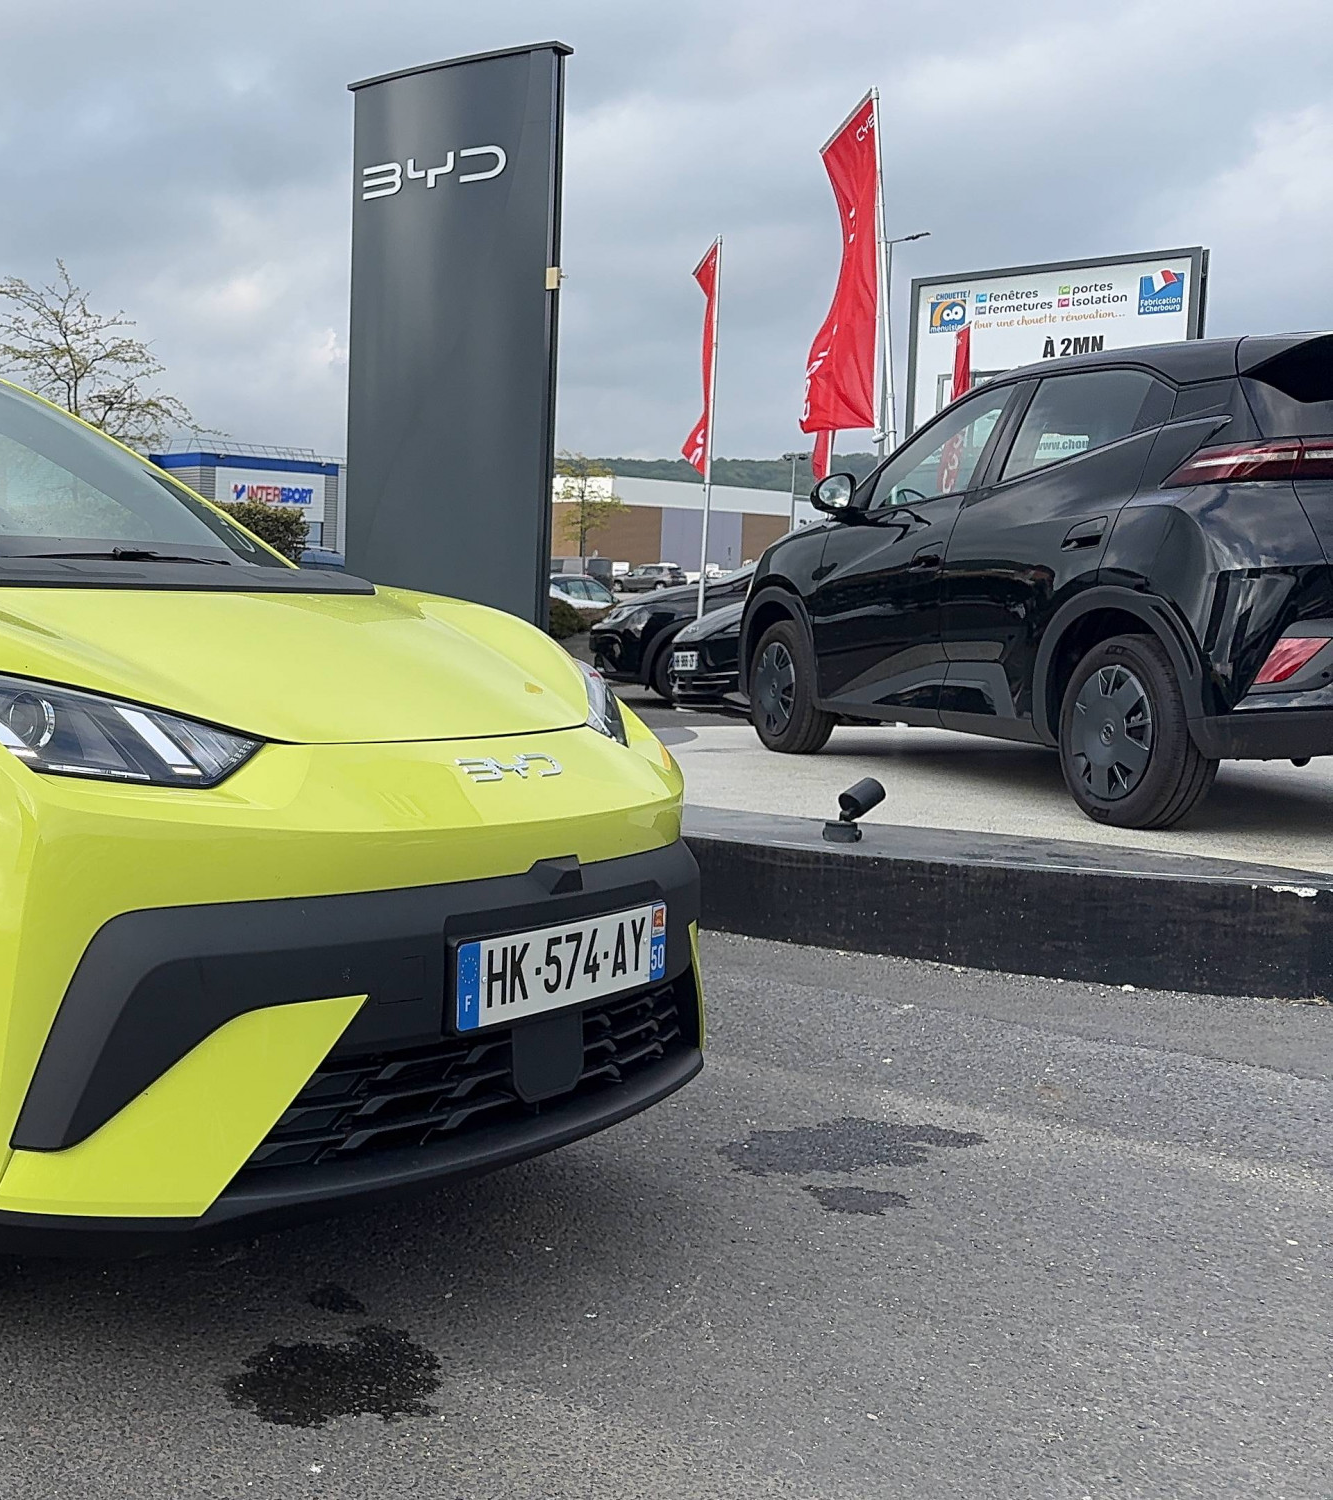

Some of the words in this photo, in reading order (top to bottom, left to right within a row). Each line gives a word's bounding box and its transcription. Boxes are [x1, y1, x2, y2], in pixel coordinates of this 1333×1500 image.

[362, 145, 508, 201] BYD
[988, 289, 1039, 304] fenêtres
[1072, 282, 1113, 296] portes
[1071, 293, 1128, 307] isolation
[1140, 296, 1182, 306] Fabrication
[1145, 303, 1181, 312] Cherbourg
[987, 301, 1053, 315] fermetures
[996, 319, 1015, 328] une
[1016, 313, 1057, 326] chouette
[1042, 335, 1056, 358] À
[1059, 335, 1104, 357] 2MN
[247, 484, 313, 504] INTERSPORT
[454, 753, 564, 783] BYD
[650, 943, 665, 971] 50
[464, 994, 473, 1013] F
